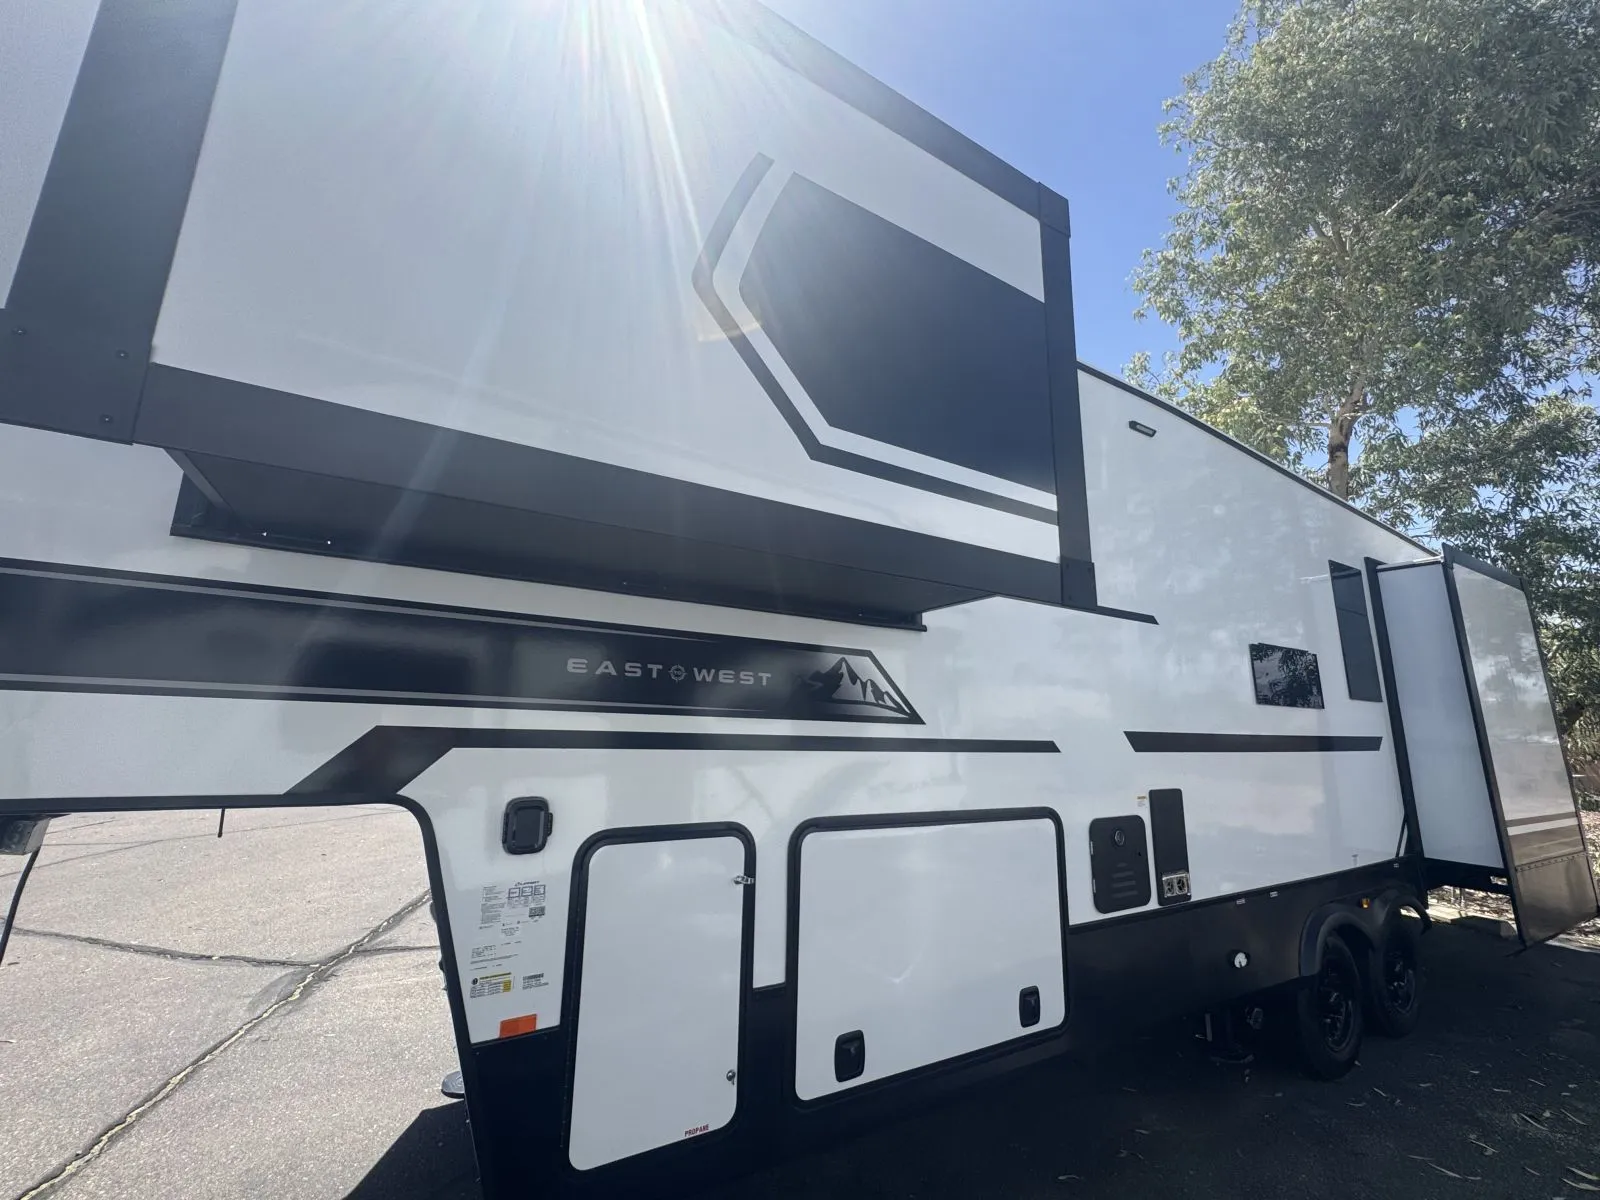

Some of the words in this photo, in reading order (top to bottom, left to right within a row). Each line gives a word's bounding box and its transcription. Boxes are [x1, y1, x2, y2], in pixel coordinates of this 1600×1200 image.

[566, 658, 663, 679] EAST
[693, 667, 772, 686] WEST
[684, 1123, 709, 1137] PROPANE
